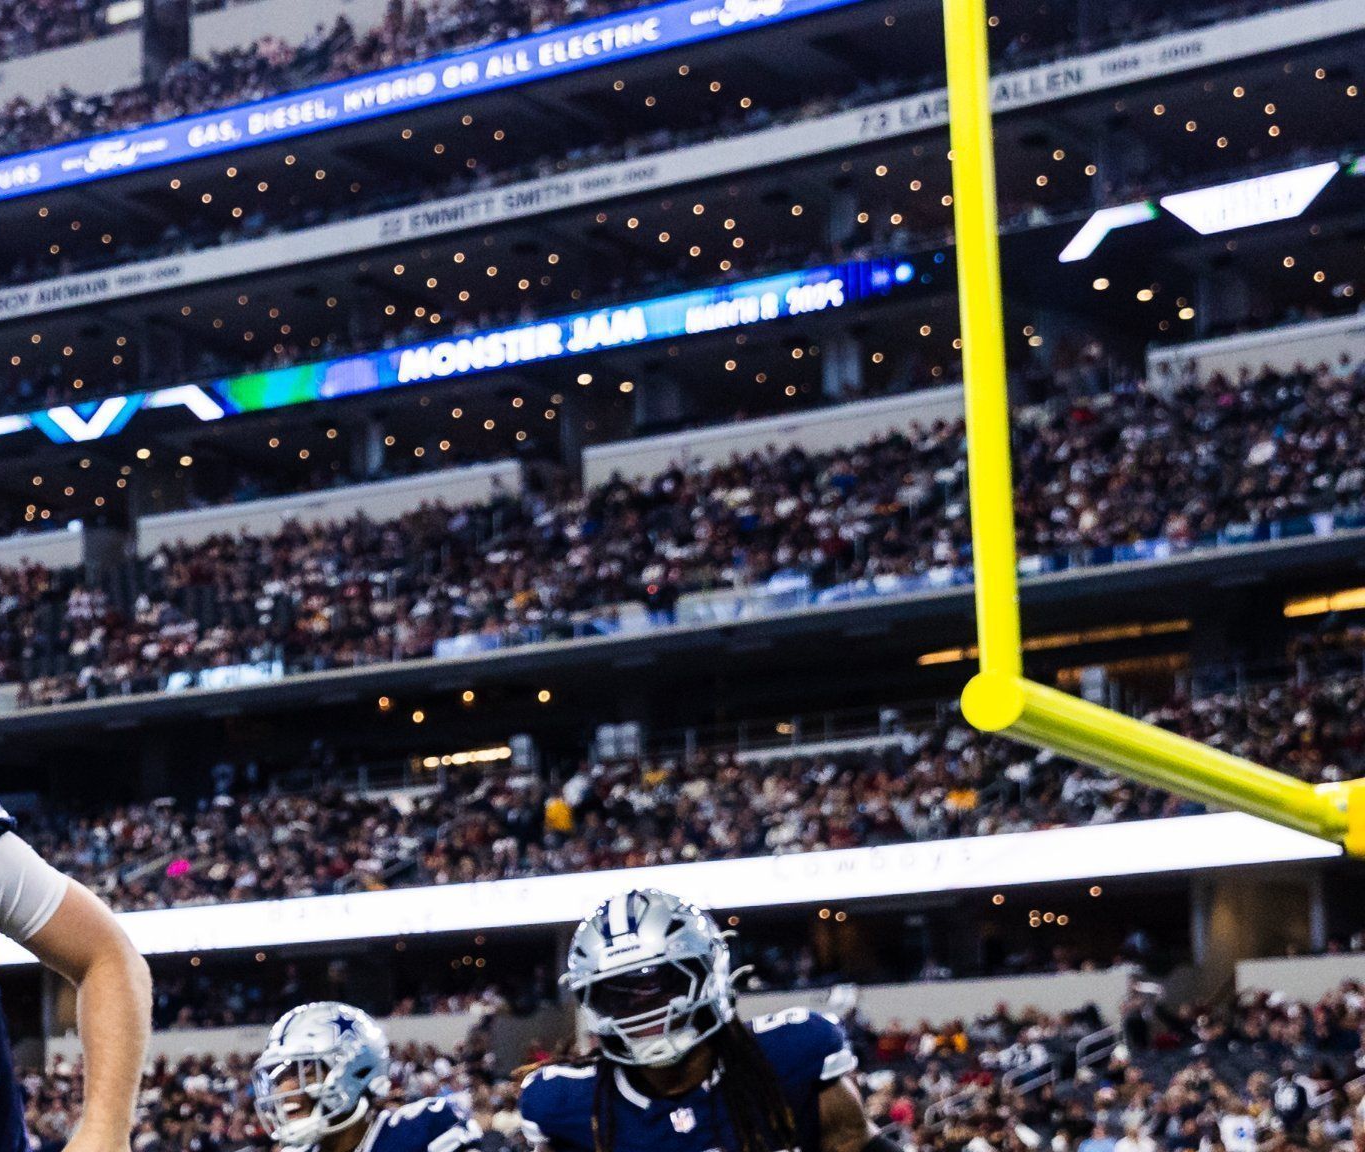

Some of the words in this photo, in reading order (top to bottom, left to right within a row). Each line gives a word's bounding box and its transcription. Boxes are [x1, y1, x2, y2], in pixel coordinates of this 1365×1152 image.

[186, 118, 242, 148] GAS,
[247, 98, 338, 136] DIESEL,
[343, 72, 437, 113] HYBRID
[442, 61, 479, 89] OR
[485, 49, 533, 80] ALL
[538, 16, 662, 67] ELECTRIC
[994, 68, 1087, 102] ALLEN
[397, 322, 563, 383] MONSTER
[567, 307, 648, 352] JAM
